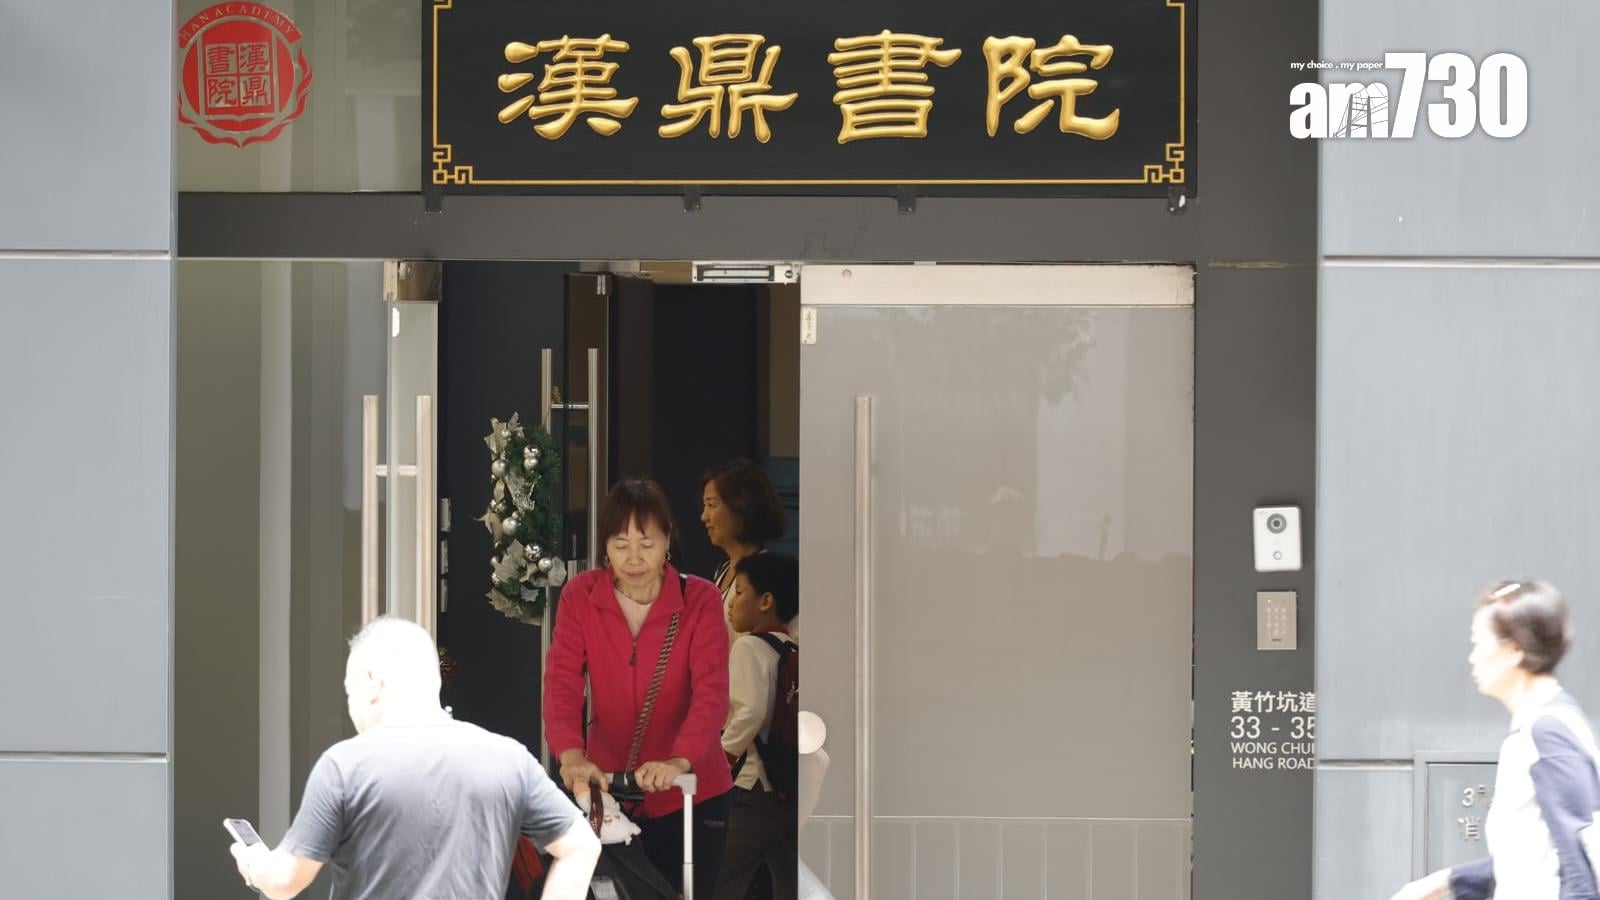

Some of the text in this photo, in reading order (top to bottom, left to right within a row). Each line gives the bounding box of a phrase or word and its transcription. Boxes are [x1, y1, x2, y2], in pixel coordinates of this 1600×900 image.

[180, 4, 294, 41] HAN ACADEMY
[497, 29, 1121, 144] 漢鼎書院
[1231, 691, 1315, 713] 黃竹坑道
[1230, 716, 1261, 739] 33
[1290, 716, 1315, 739] 35
[1230, 742, 1278, 754] WONG
[1232, 757, 1274, 769] HANG
